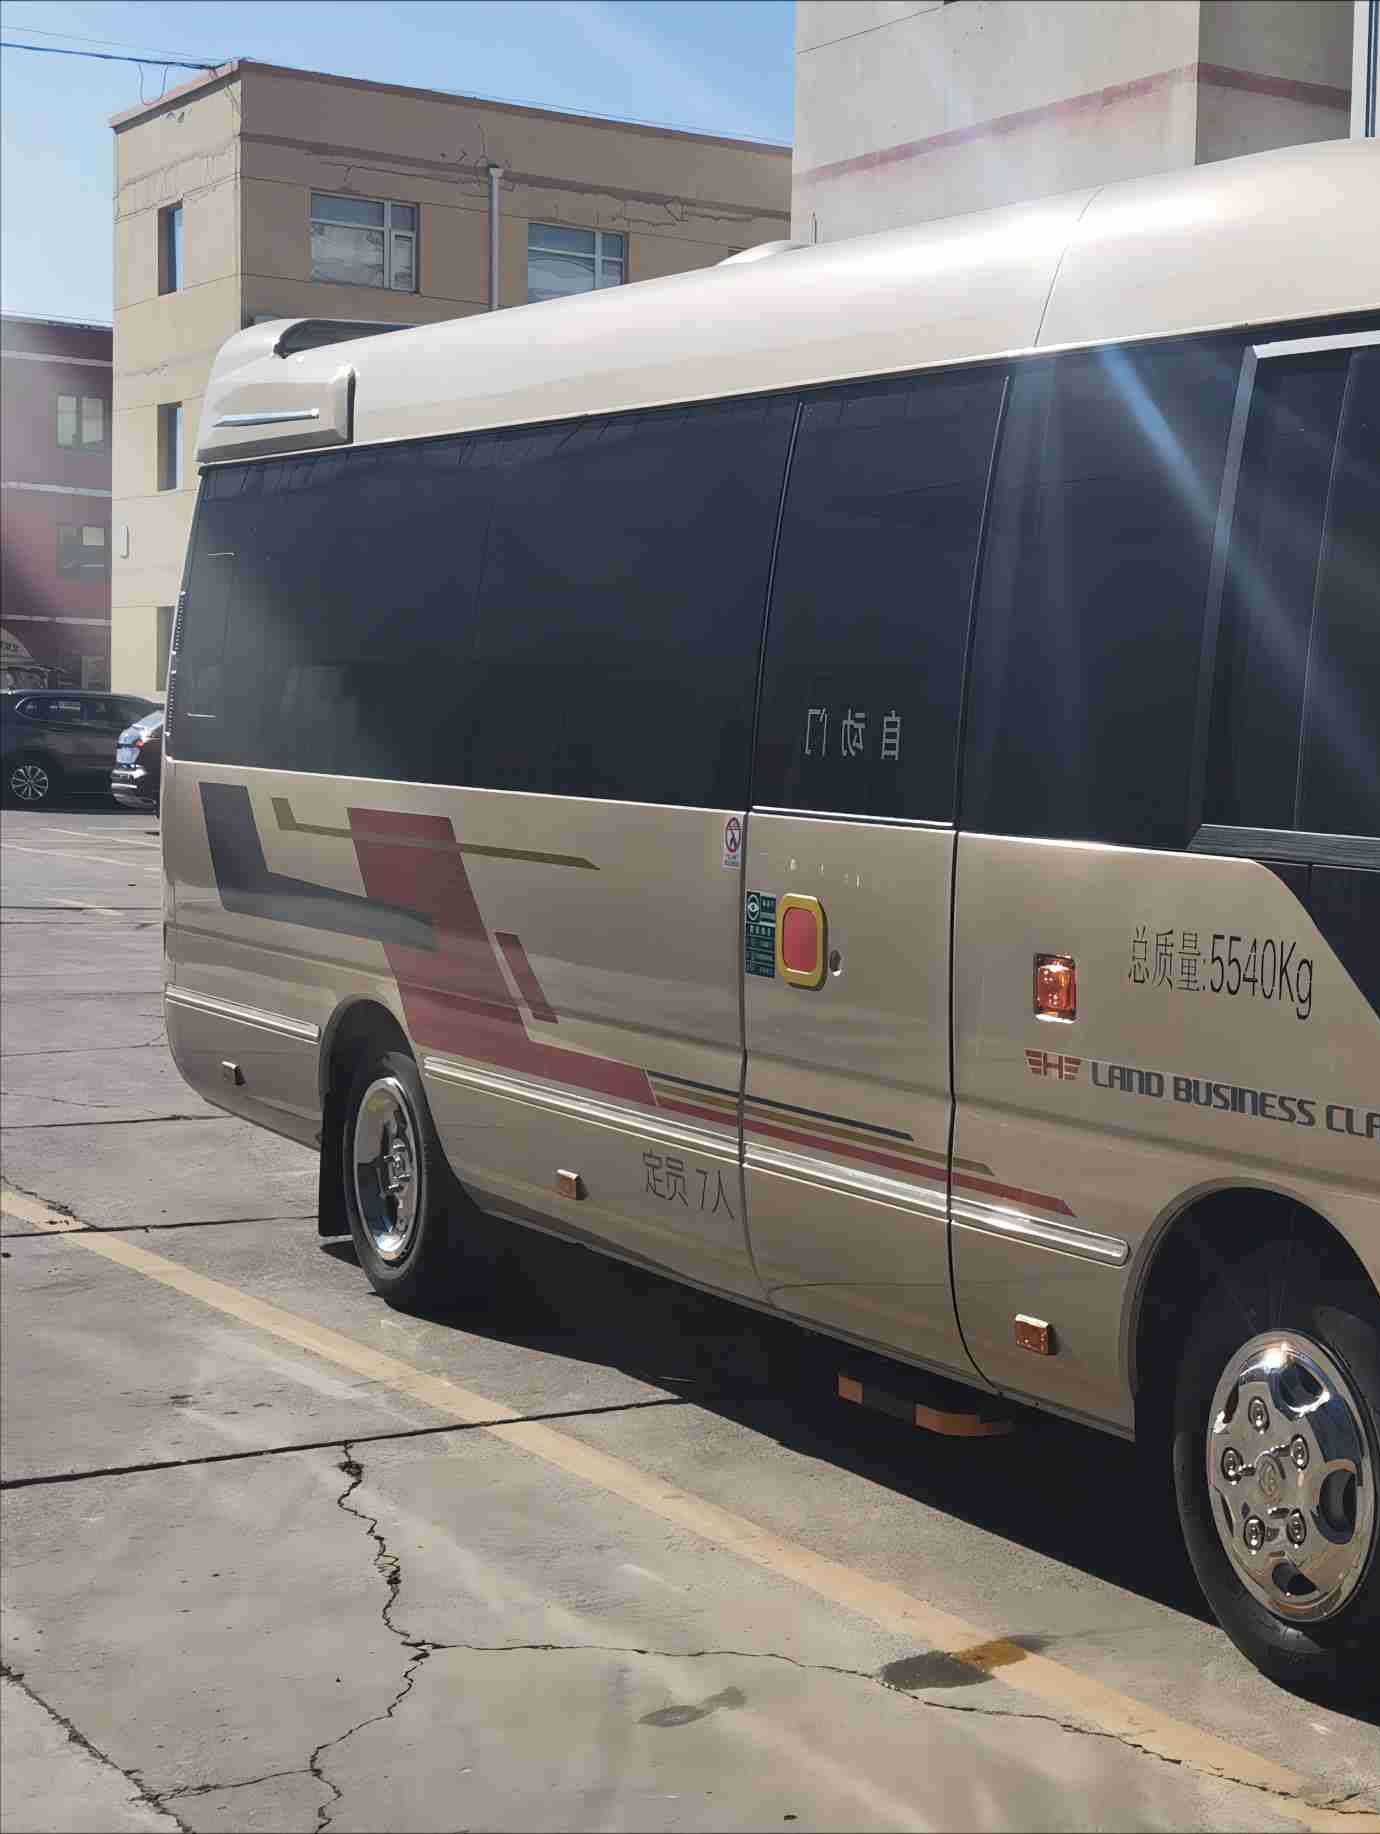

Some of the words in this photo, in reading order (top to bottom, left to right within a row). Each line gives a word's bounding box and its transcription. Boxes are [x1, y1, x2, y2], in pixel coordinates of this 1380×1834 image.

[1128, 925, 1313, 1020] 总质量:5540Kg
[1091, 1060, 1164, 1098] LAND
[1173, 1075, 1317, 1127] BUSINESS
[642, 1148, 688, 1207] 定员
[696, 1168, 735, 1219] 7人
